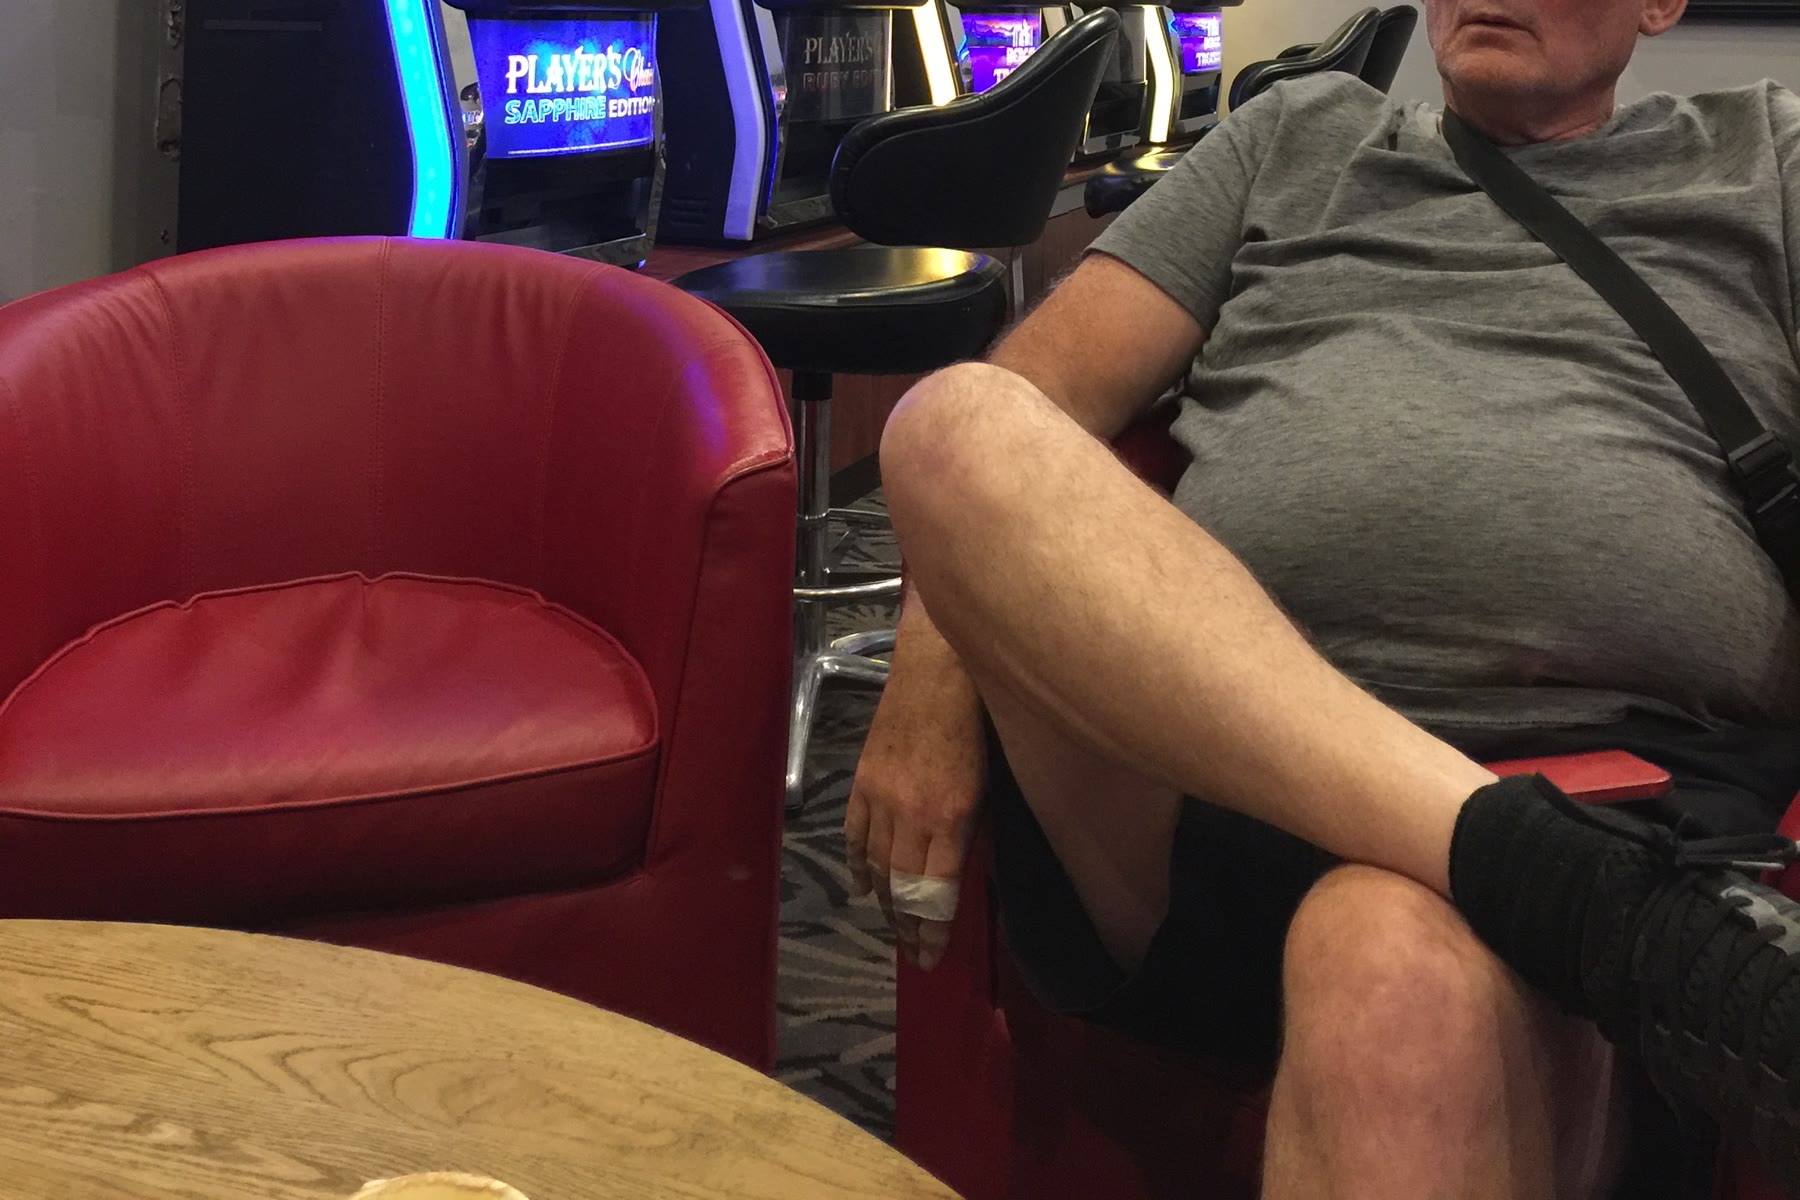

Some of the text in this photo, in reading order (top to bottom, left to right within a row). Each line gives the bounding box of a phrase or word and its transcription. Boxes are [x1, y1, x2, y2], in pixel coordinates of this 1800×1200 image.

[804, 31, 873, 64] PLAYER'S
[505, 45, 622, 94] PLAYER'S
[504, 95, 607, 125] SAPPHIRE
